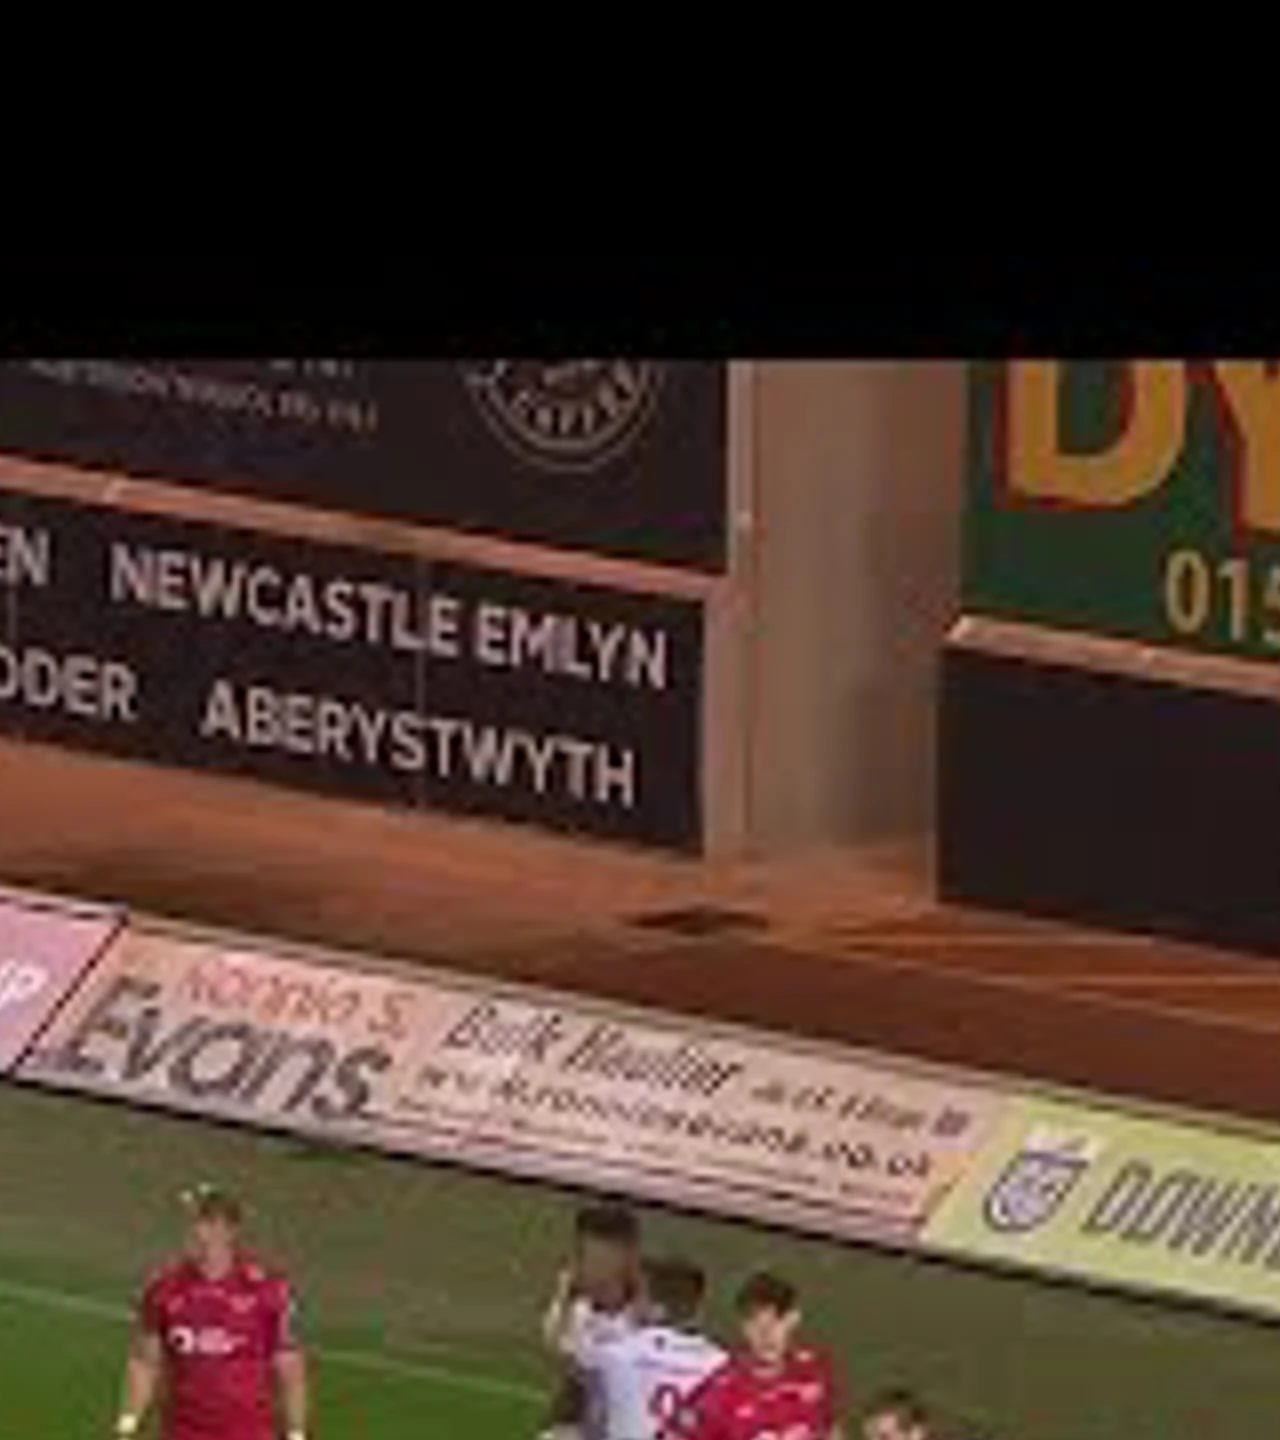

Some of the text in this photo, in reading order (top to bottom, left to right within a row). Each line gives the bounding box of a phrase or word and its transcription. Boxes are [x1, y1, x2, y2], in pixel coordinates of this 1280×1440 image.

[111, 543, 459, 656] NEWCASTLE
[475, 606, 666, 690] EMLYN
[200, 681, 635, 808] ABERYSTWYTH
[55, 977, 392, 1119] Evans
